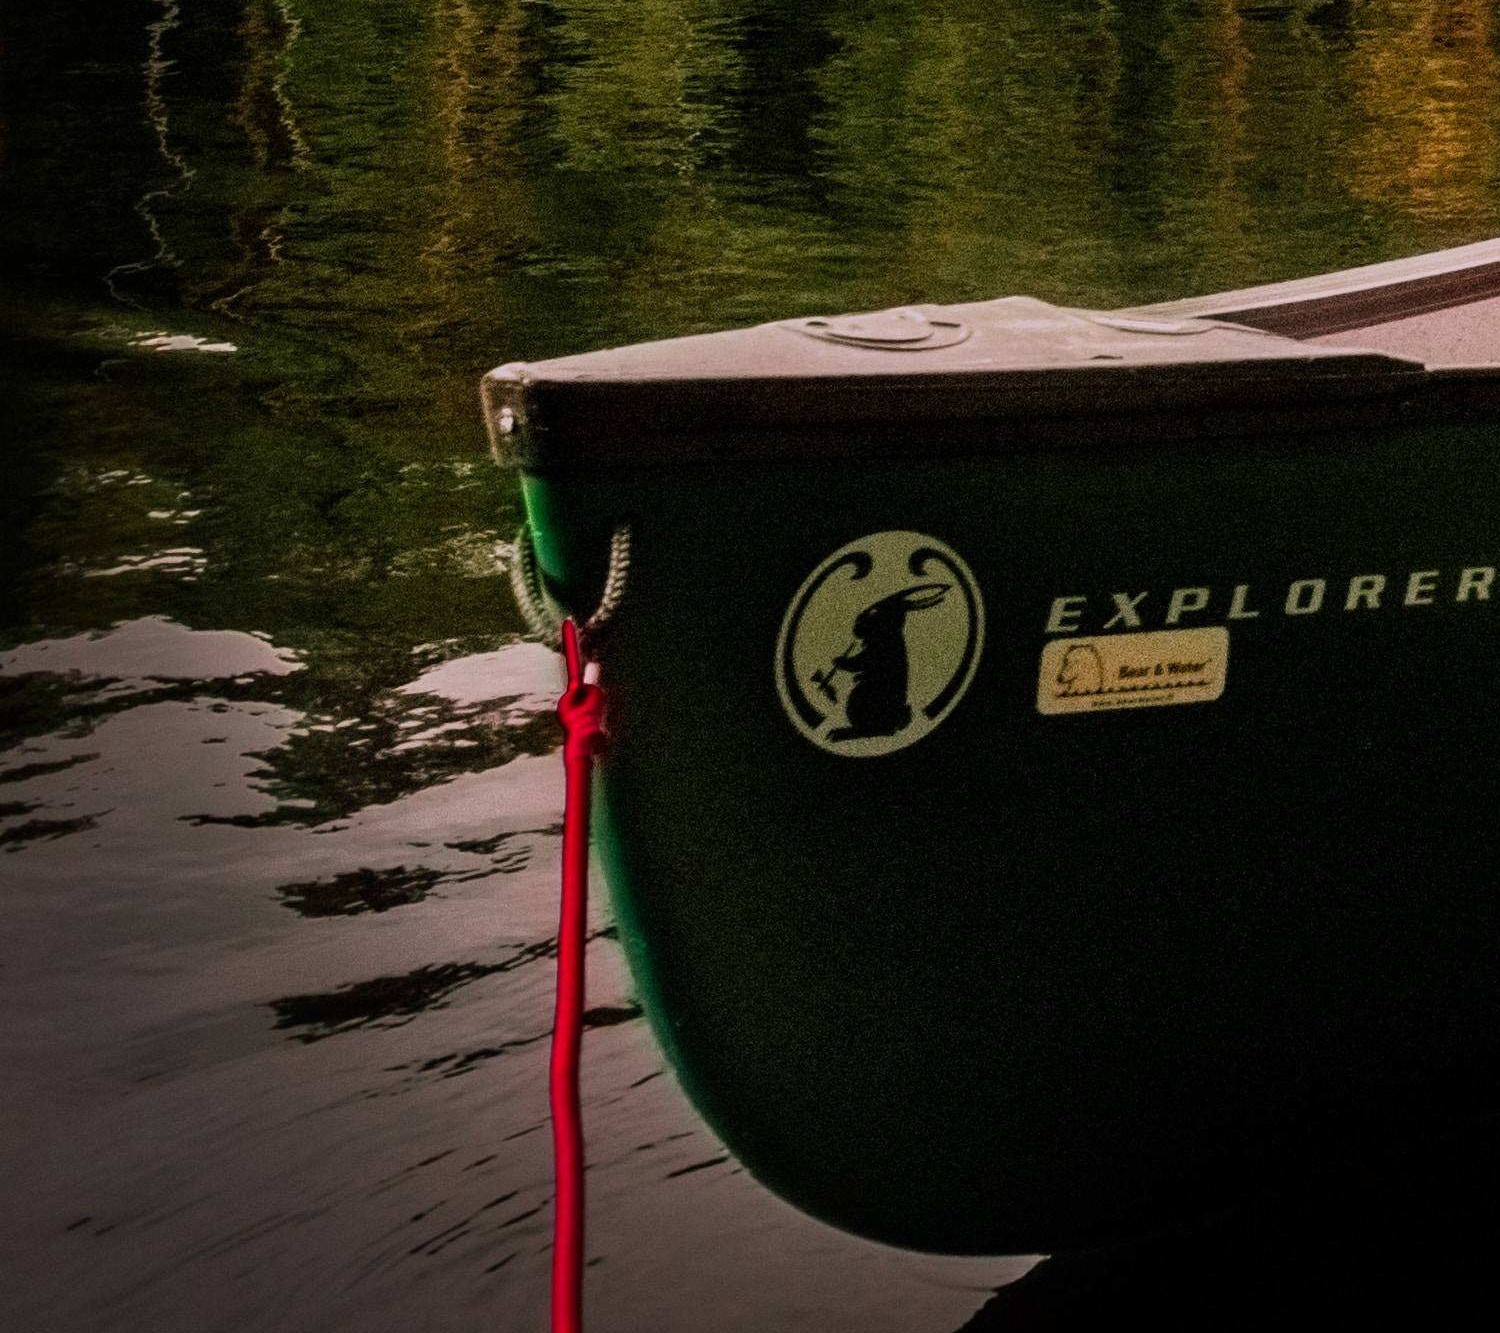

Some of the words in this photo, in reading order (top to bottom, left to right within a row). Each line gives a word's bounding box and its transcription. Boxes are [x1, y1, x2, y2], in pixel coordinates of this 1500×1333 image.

[1044, 566, 1498, 633] EXPLORER
[1119, 665, 1150, 679] Bear
[1154, 662, 1164, 676] &
